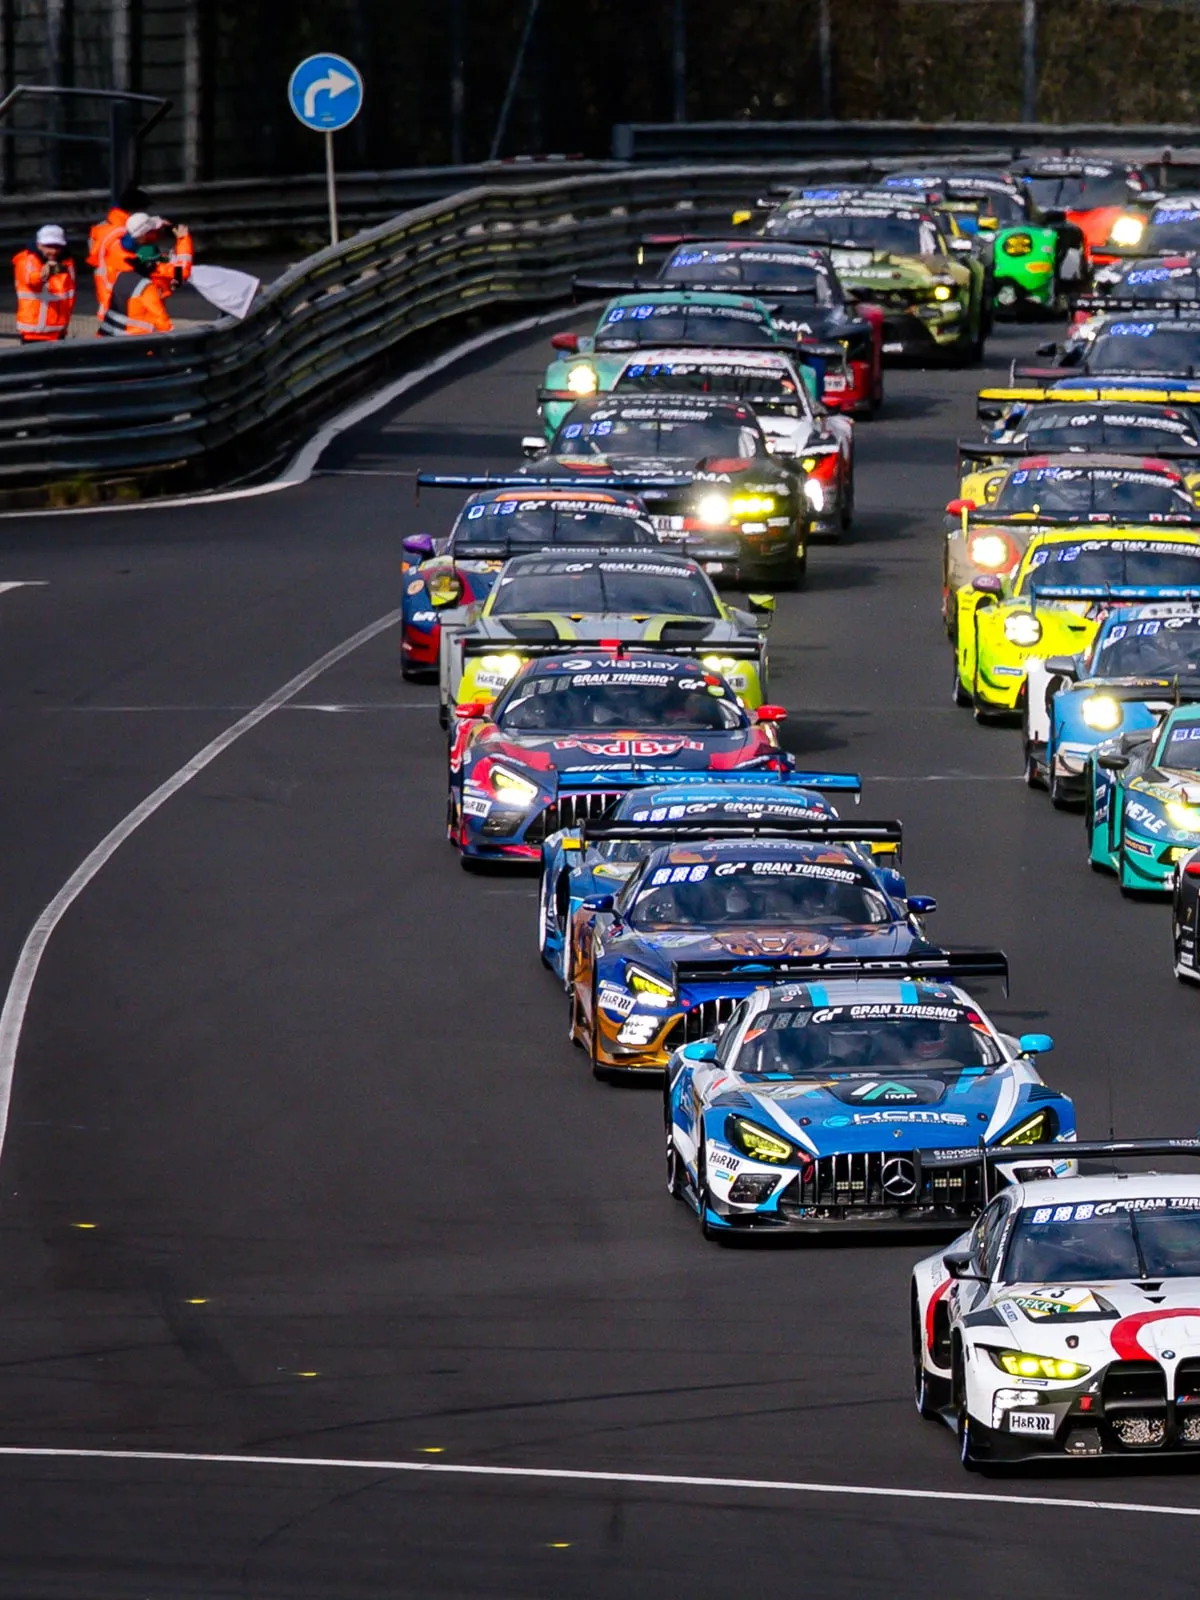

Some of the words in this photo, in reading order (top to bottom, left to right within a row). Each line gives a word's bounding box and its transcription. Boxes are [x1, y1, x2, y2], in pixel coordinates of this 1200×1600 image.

[596, 660, 679, 671] viaplay
[573, 673, 609, 683] GRAN
[612, 674, 669, 683] TURISMO
[723, 803, 764, 812] GRAN
[768, 804, 829, 820] TURISMO
[752, 862, 790, 872] GRAN
[795, 863, 856, 881] TURISMO
[850, 1005, 892, 1015] GRAN
[895, 1005, 958, 1018] TURISMO
[1126, 1199, 1166, 1209] GRAN
